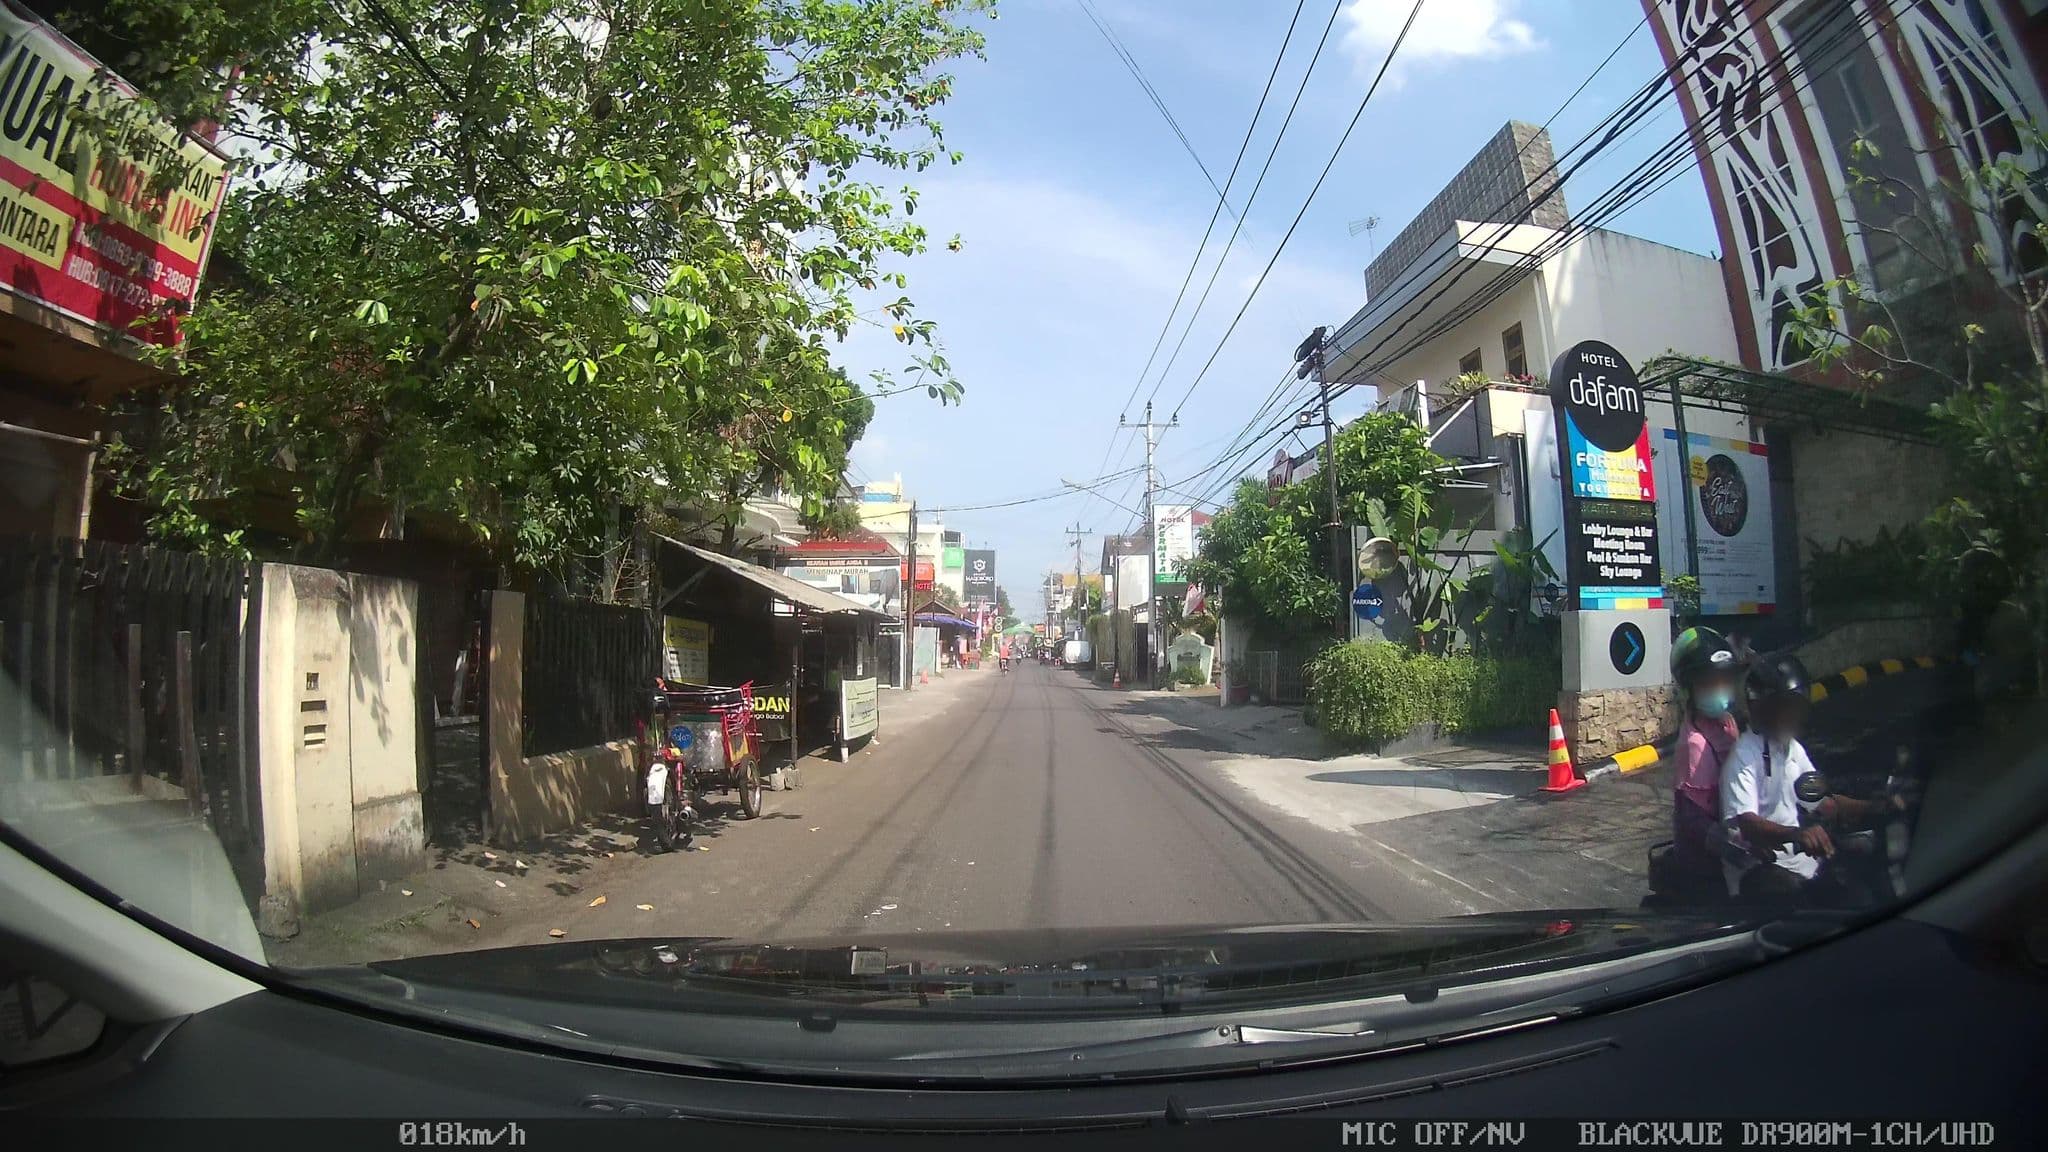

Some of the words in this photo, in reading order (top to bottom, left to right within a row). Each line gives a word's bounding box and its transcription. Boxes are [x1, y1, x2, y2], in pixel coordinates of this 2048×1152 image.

[1581, 352, 1618, 368] HOTEL
[1570, 372, 1639, 416] dafam
[1576, 452, 1647, 473] FORTUNA
[1600, 565, 1614, 579] Sky
